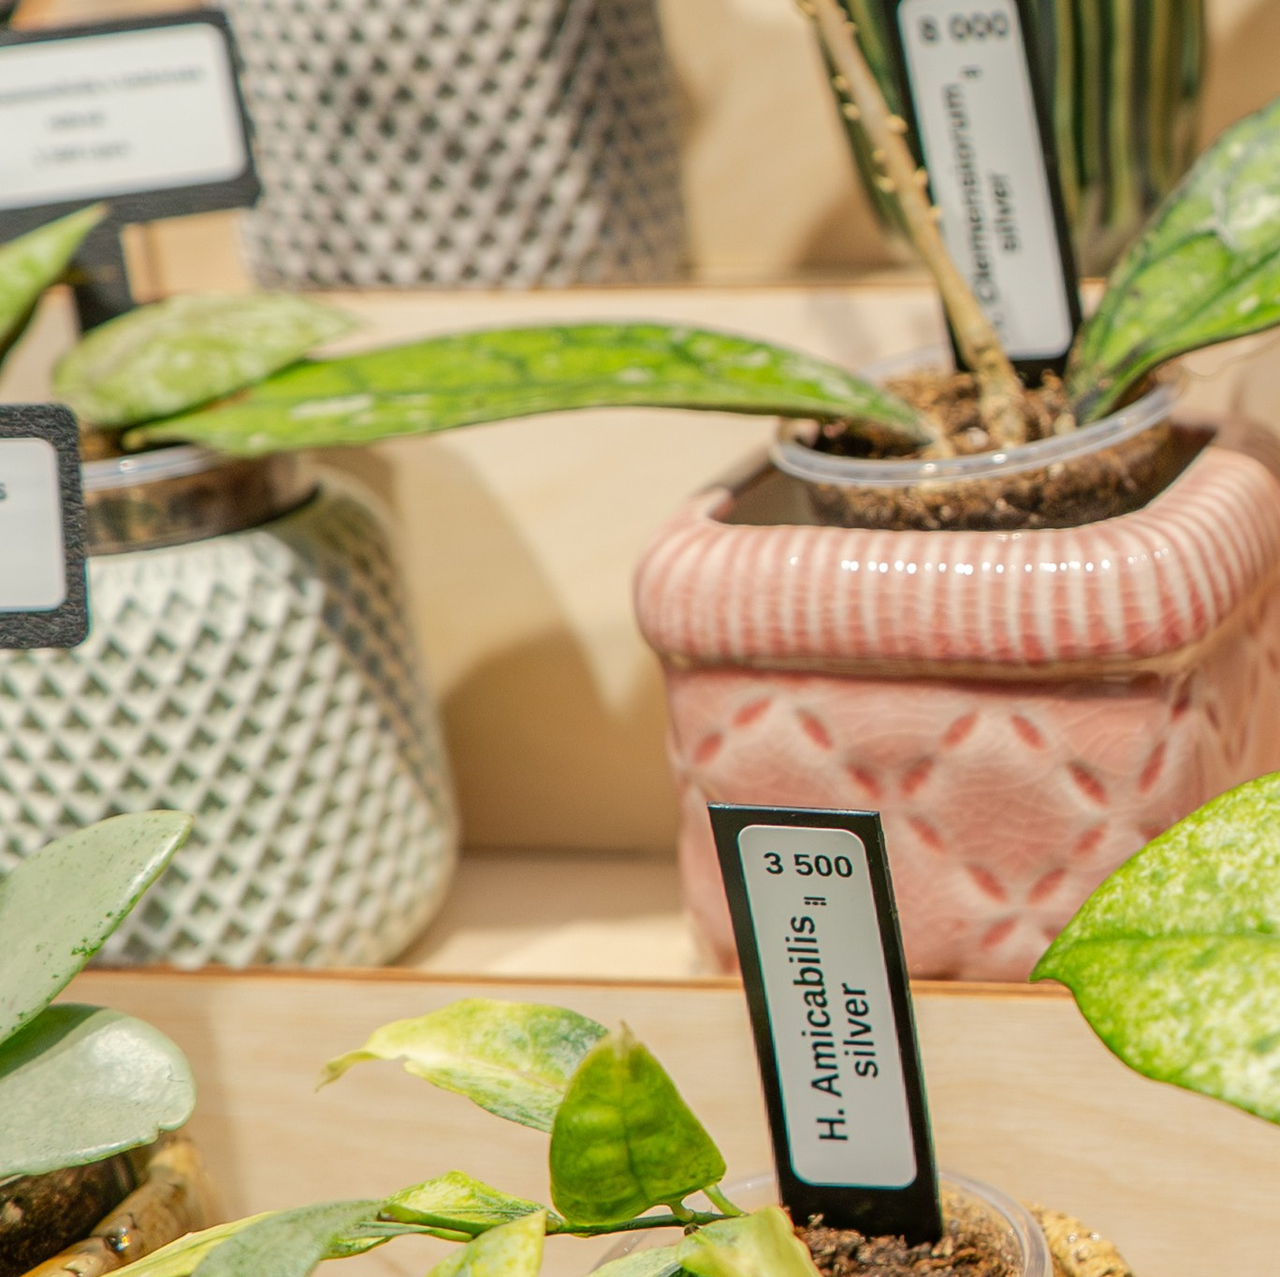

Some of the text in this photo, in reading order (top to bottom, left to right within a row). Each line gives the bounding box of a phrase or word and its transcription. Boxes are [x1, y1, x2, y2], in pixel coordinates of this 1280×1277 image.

[949, 9, 1009, 43] 000
[763, 851, 854, 879] 3 500
[784, 915, 849, 1142] H. Amicabilis
[840, 982, 879, 1079] silver
